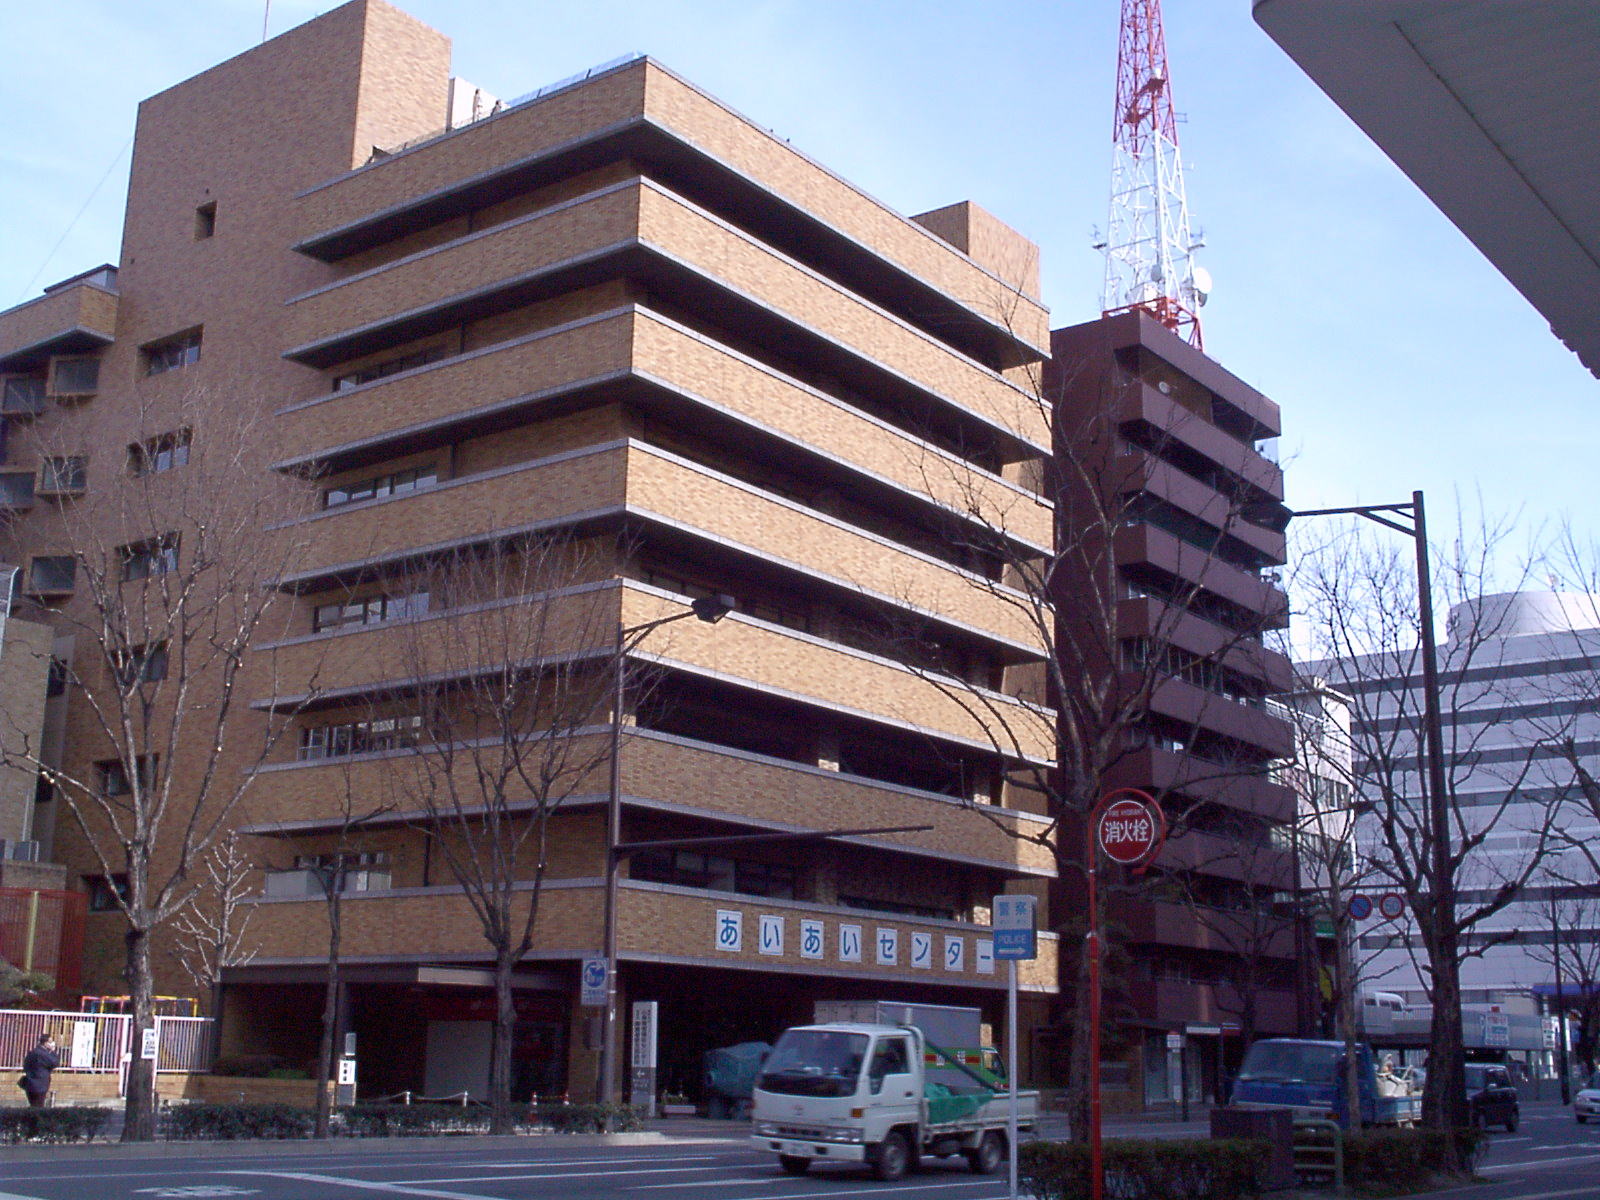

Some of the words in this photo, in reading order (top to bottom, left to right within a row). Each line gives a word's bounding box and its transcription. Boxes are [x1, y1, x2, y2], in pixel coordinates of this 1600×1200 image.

[1105, 818, 1149, 844] 消火栓
[719, 915, 991, 966] あいあいセンター
[997, 934, 1027, 945] POLICE
